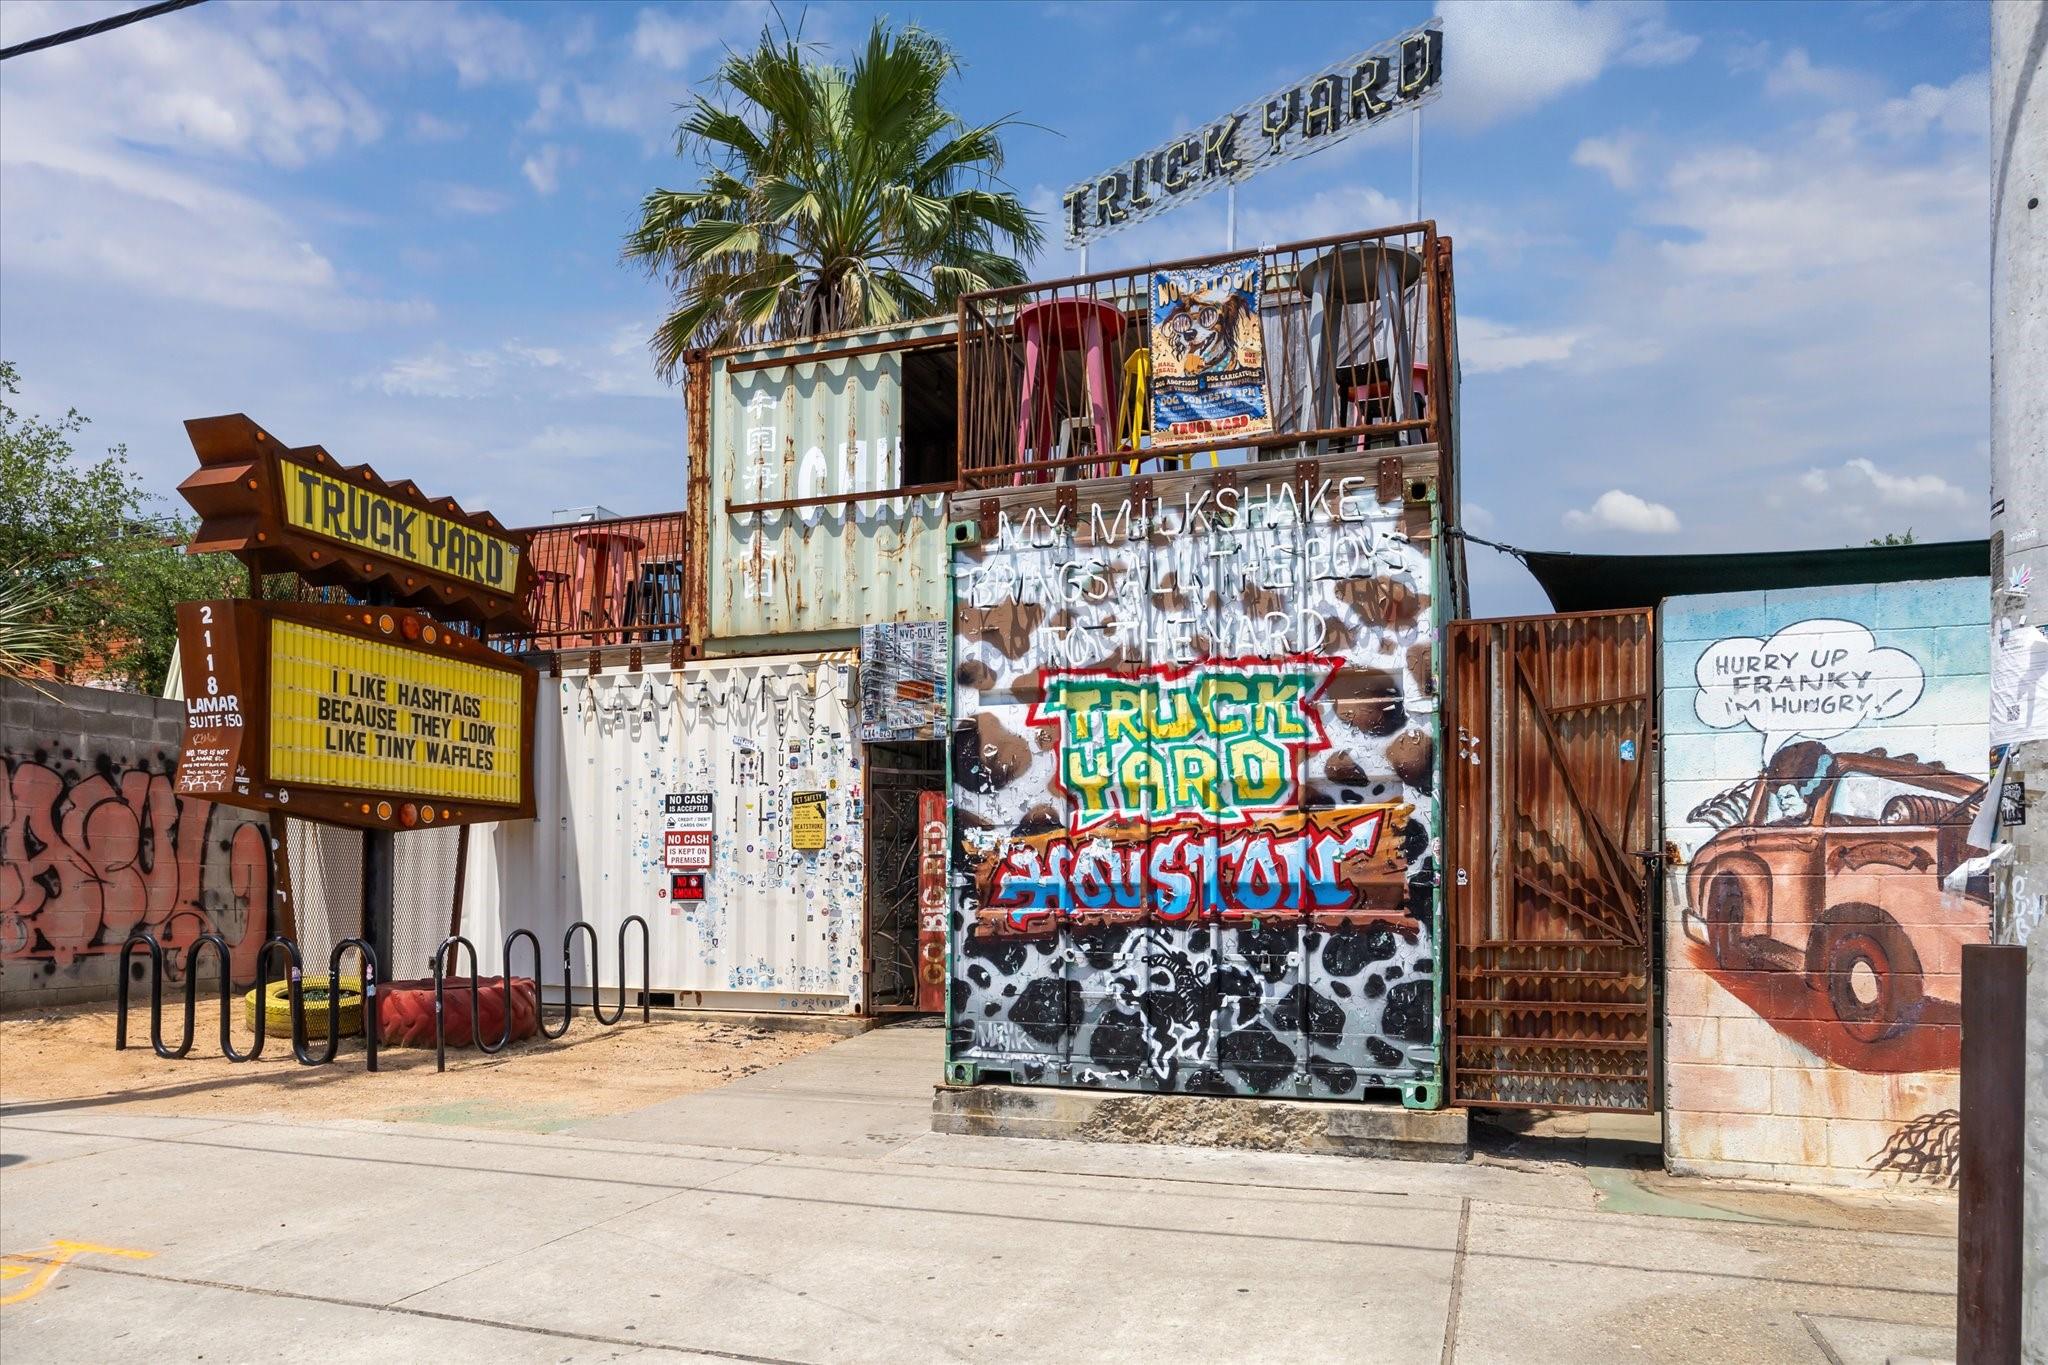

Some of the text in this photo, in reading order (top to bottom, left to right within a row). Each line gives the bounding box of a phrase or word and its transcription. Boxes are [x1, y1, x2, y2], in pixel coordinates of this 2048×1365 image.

[1063, 29, 1443, 239] TRUCK YARD
[1161, 395, 1179, 405] DOG
[1182, 389, 1232, 405] CONTESTS
[1171, 421, 1212, 435] TRUCK
[1216, 415, 1249, 430] YARD
[298, 470, 503, 584] TRUCK YARD
[998, 476, 1367, 551] MY MILKSHAKE
[966, 557, 1108, 608] BRINGS
[1122, 550, 1205, 597] ALL
[1305, 532, 1411, 582] BOYS
[1041, 607, 1328, 668] TO THE YARD
[1715, 648, 1849, 676] HURRY UP
[332, 670, 481, 721] I LIKE HASHTAGS
[1731, 670, 1873, 695] FRANKY
[187, 694, 239, 714] LAMAR
[1044, 674, 1315, 745] TRUCK
[189, 713, 243, 728] SUITE 150
[318, 696, 497, 748] BECAUSE THEY LOOK
[326, 726, 494, 772] LIKE TINY WAFFLES
[1063, 735, 1291, 820] YARD
[669, 795, 708, 805] NO CASH
[669, 805, 709, 813] IS ACCEPTED
[804, 794, 822, 802] SAFETY
[668, 834, 709, 844] NO CASH
[677, 876, 687, 887] NO
[996, 812, 1383, 928] HOUSTON
[673, 888, 703, 899] SMOKING
